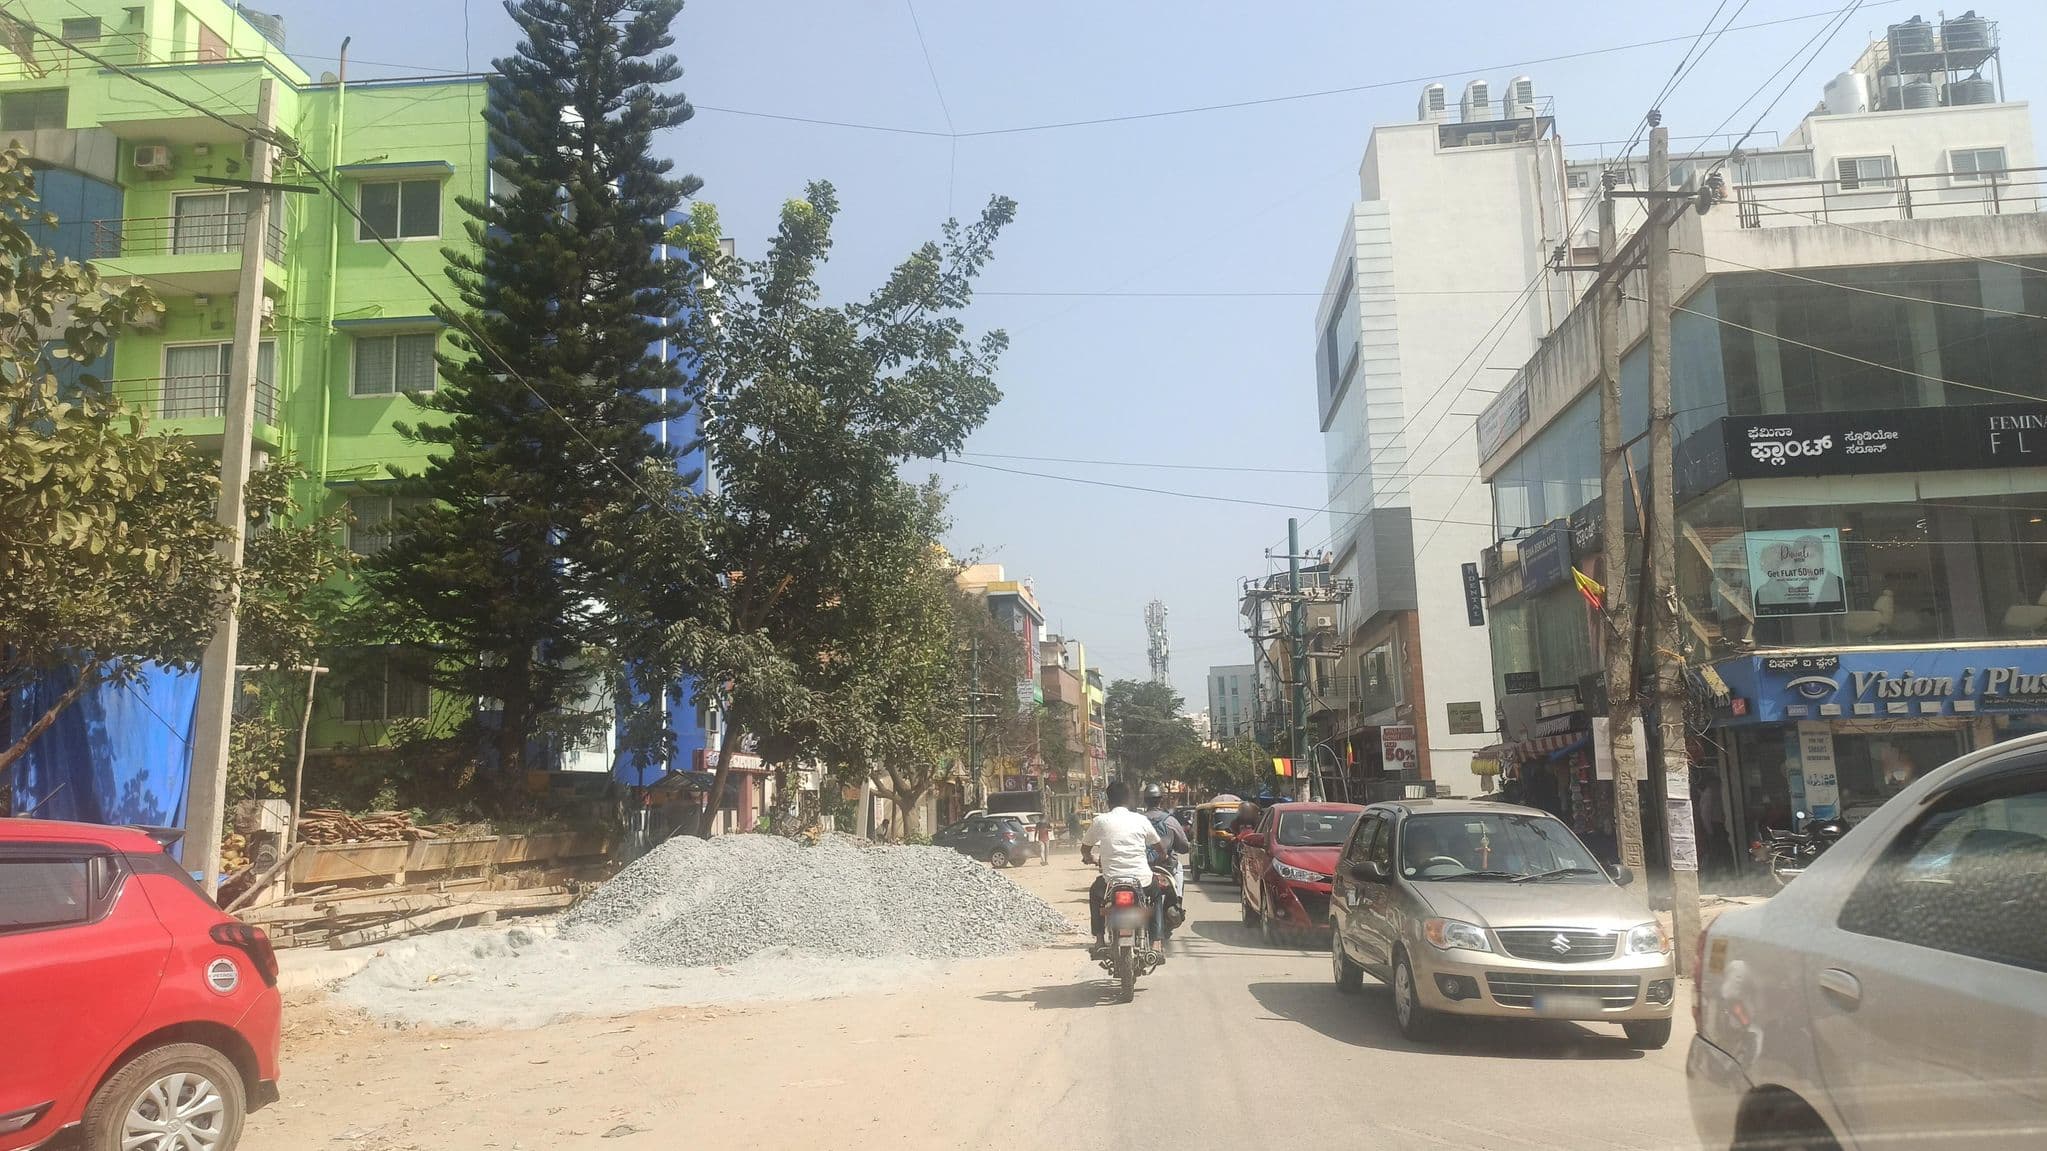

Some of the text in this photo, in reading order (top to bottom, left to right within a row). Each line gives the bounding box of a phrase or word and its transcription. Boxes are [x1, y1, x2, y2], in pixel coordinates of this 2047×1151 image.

[1748, 426, 1793, 439] ಫೆಮಿನಾ
[1750, 435, 1833, 466] ಫ್ಲಾಂಟ್
[1846, 443, 1888, 455] ಸಲೂನ್
[1767, 569, 1780, 578] Get
[1781, 569, 1797, 577] FLAT
[1851, 669, 1953, 700] Vision
[1963, 667, 1976, 696] i
[1385, 748, 1416, 762] 50%
